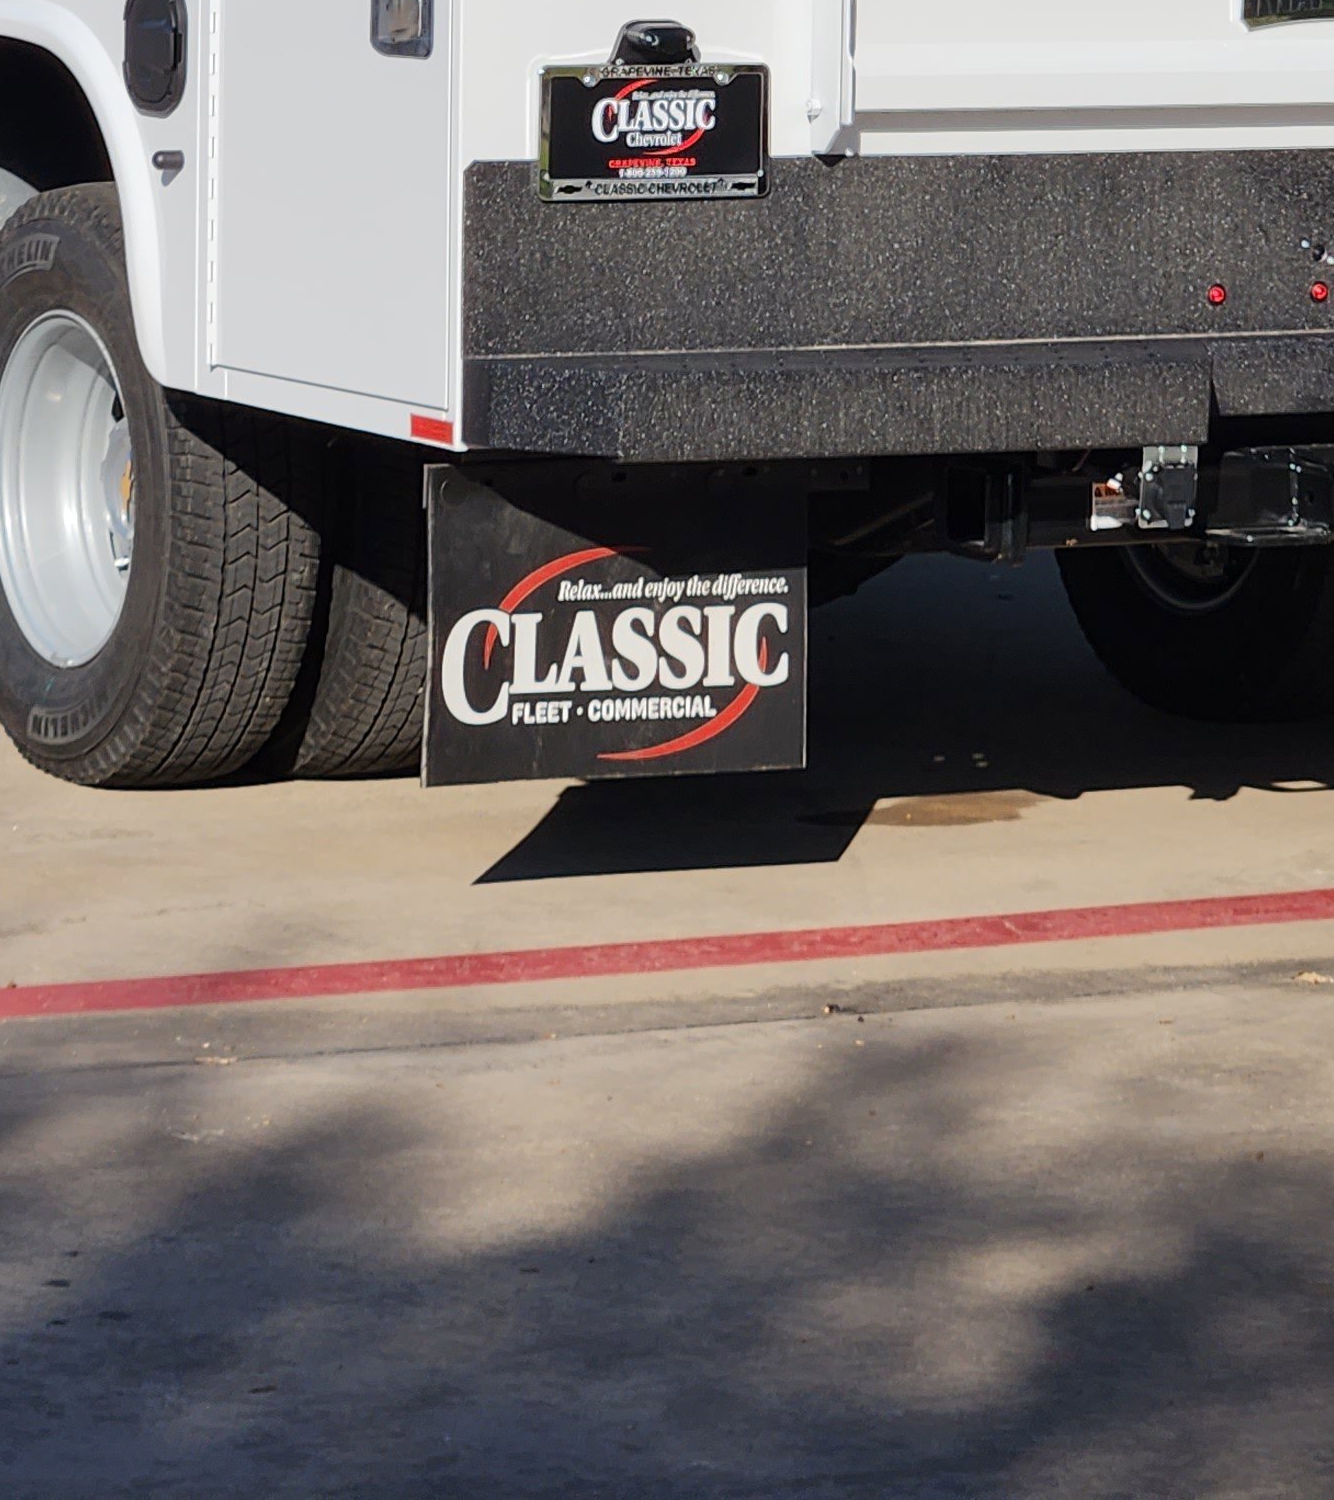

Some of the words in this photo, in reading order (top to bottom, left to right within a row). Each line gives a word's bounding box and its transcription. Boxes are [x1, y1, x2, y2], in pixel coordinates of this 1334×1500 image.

[591, 97, 716, 142] CLASSIC
[626, 132, 682, 148] Chevrolet
[594, 183, 645, 196] CLASSIC
[648, 181, 717, 194] CHEVROLET
[645, 576, 685, 603] enjoy
[686, 573, 711, 597] the
[712, 572, 789, 601] difference.
[442, 602, 789, 725] CLASSIC
[511, 700, 572, 726] FLEET
[587, 695, 717, 723] COMMERCIAL
